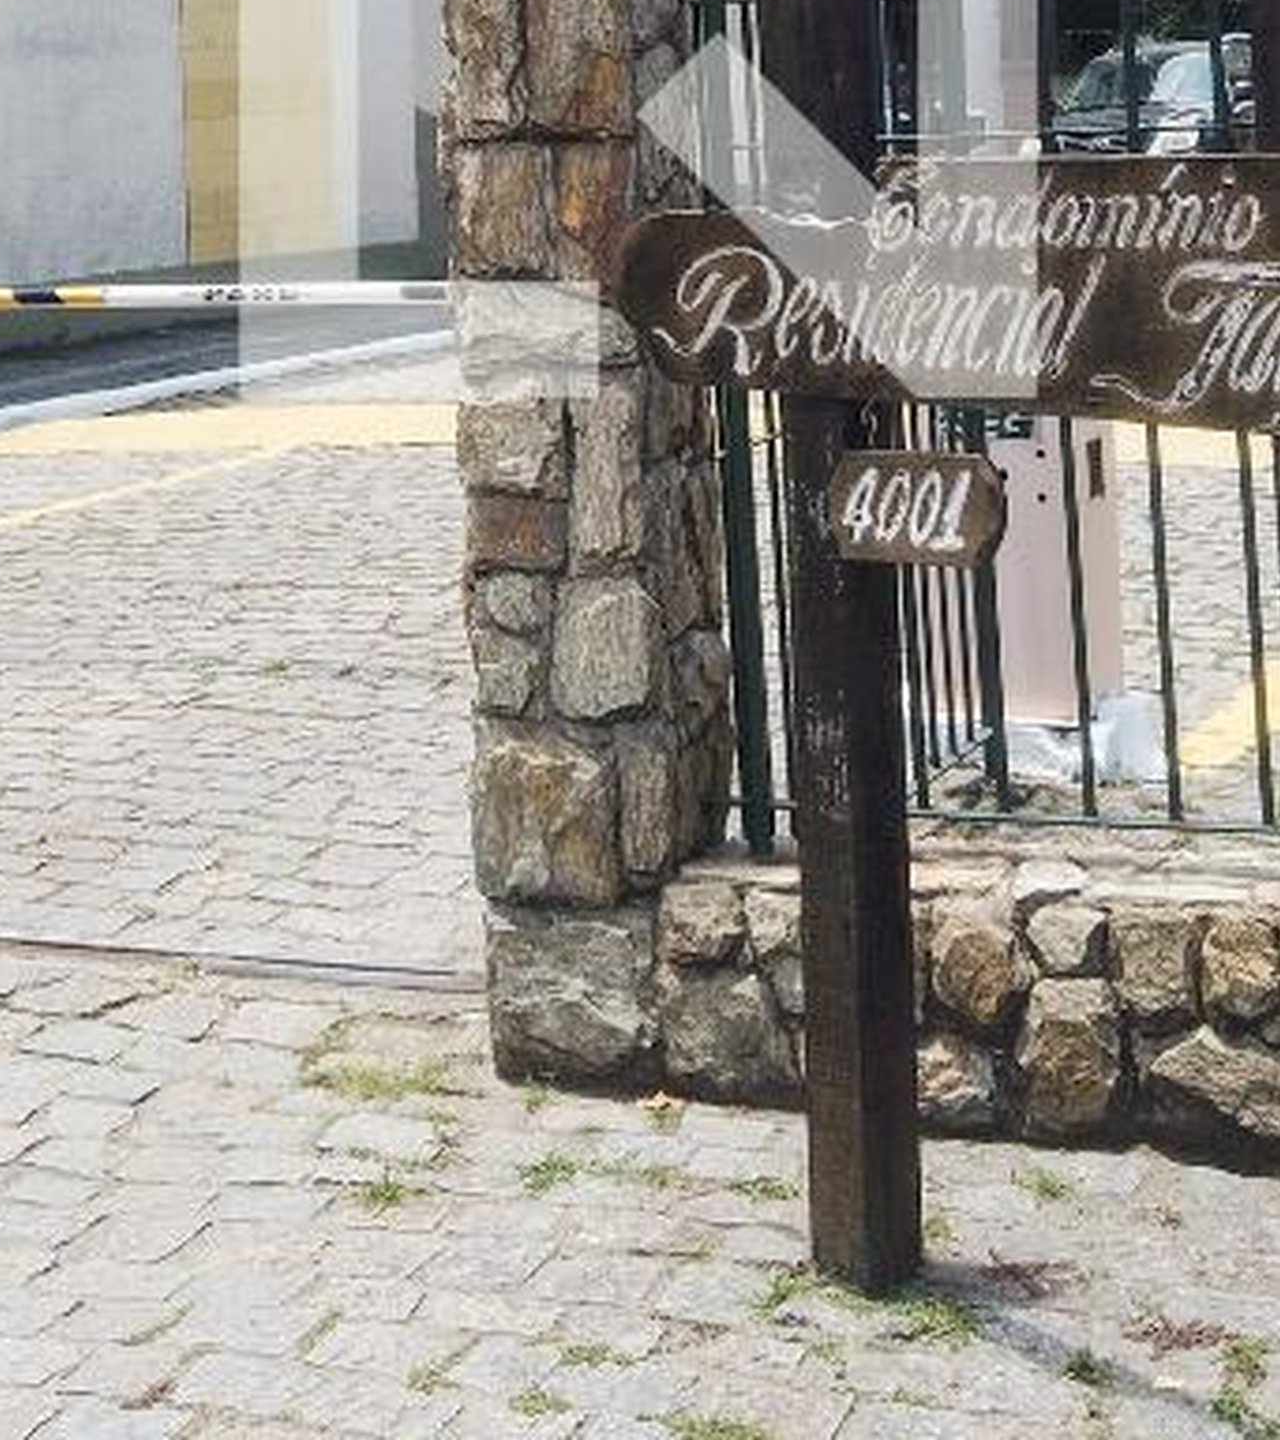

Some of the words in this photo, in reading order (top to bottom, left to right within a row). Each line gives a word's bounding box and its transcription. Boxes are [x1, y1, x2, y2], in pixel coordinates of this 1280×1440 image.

[865, 160, 1266, 254] Condomínio
[652, 244, 1108, 381] Residencial
[841, 466, 972, 551] 4001
